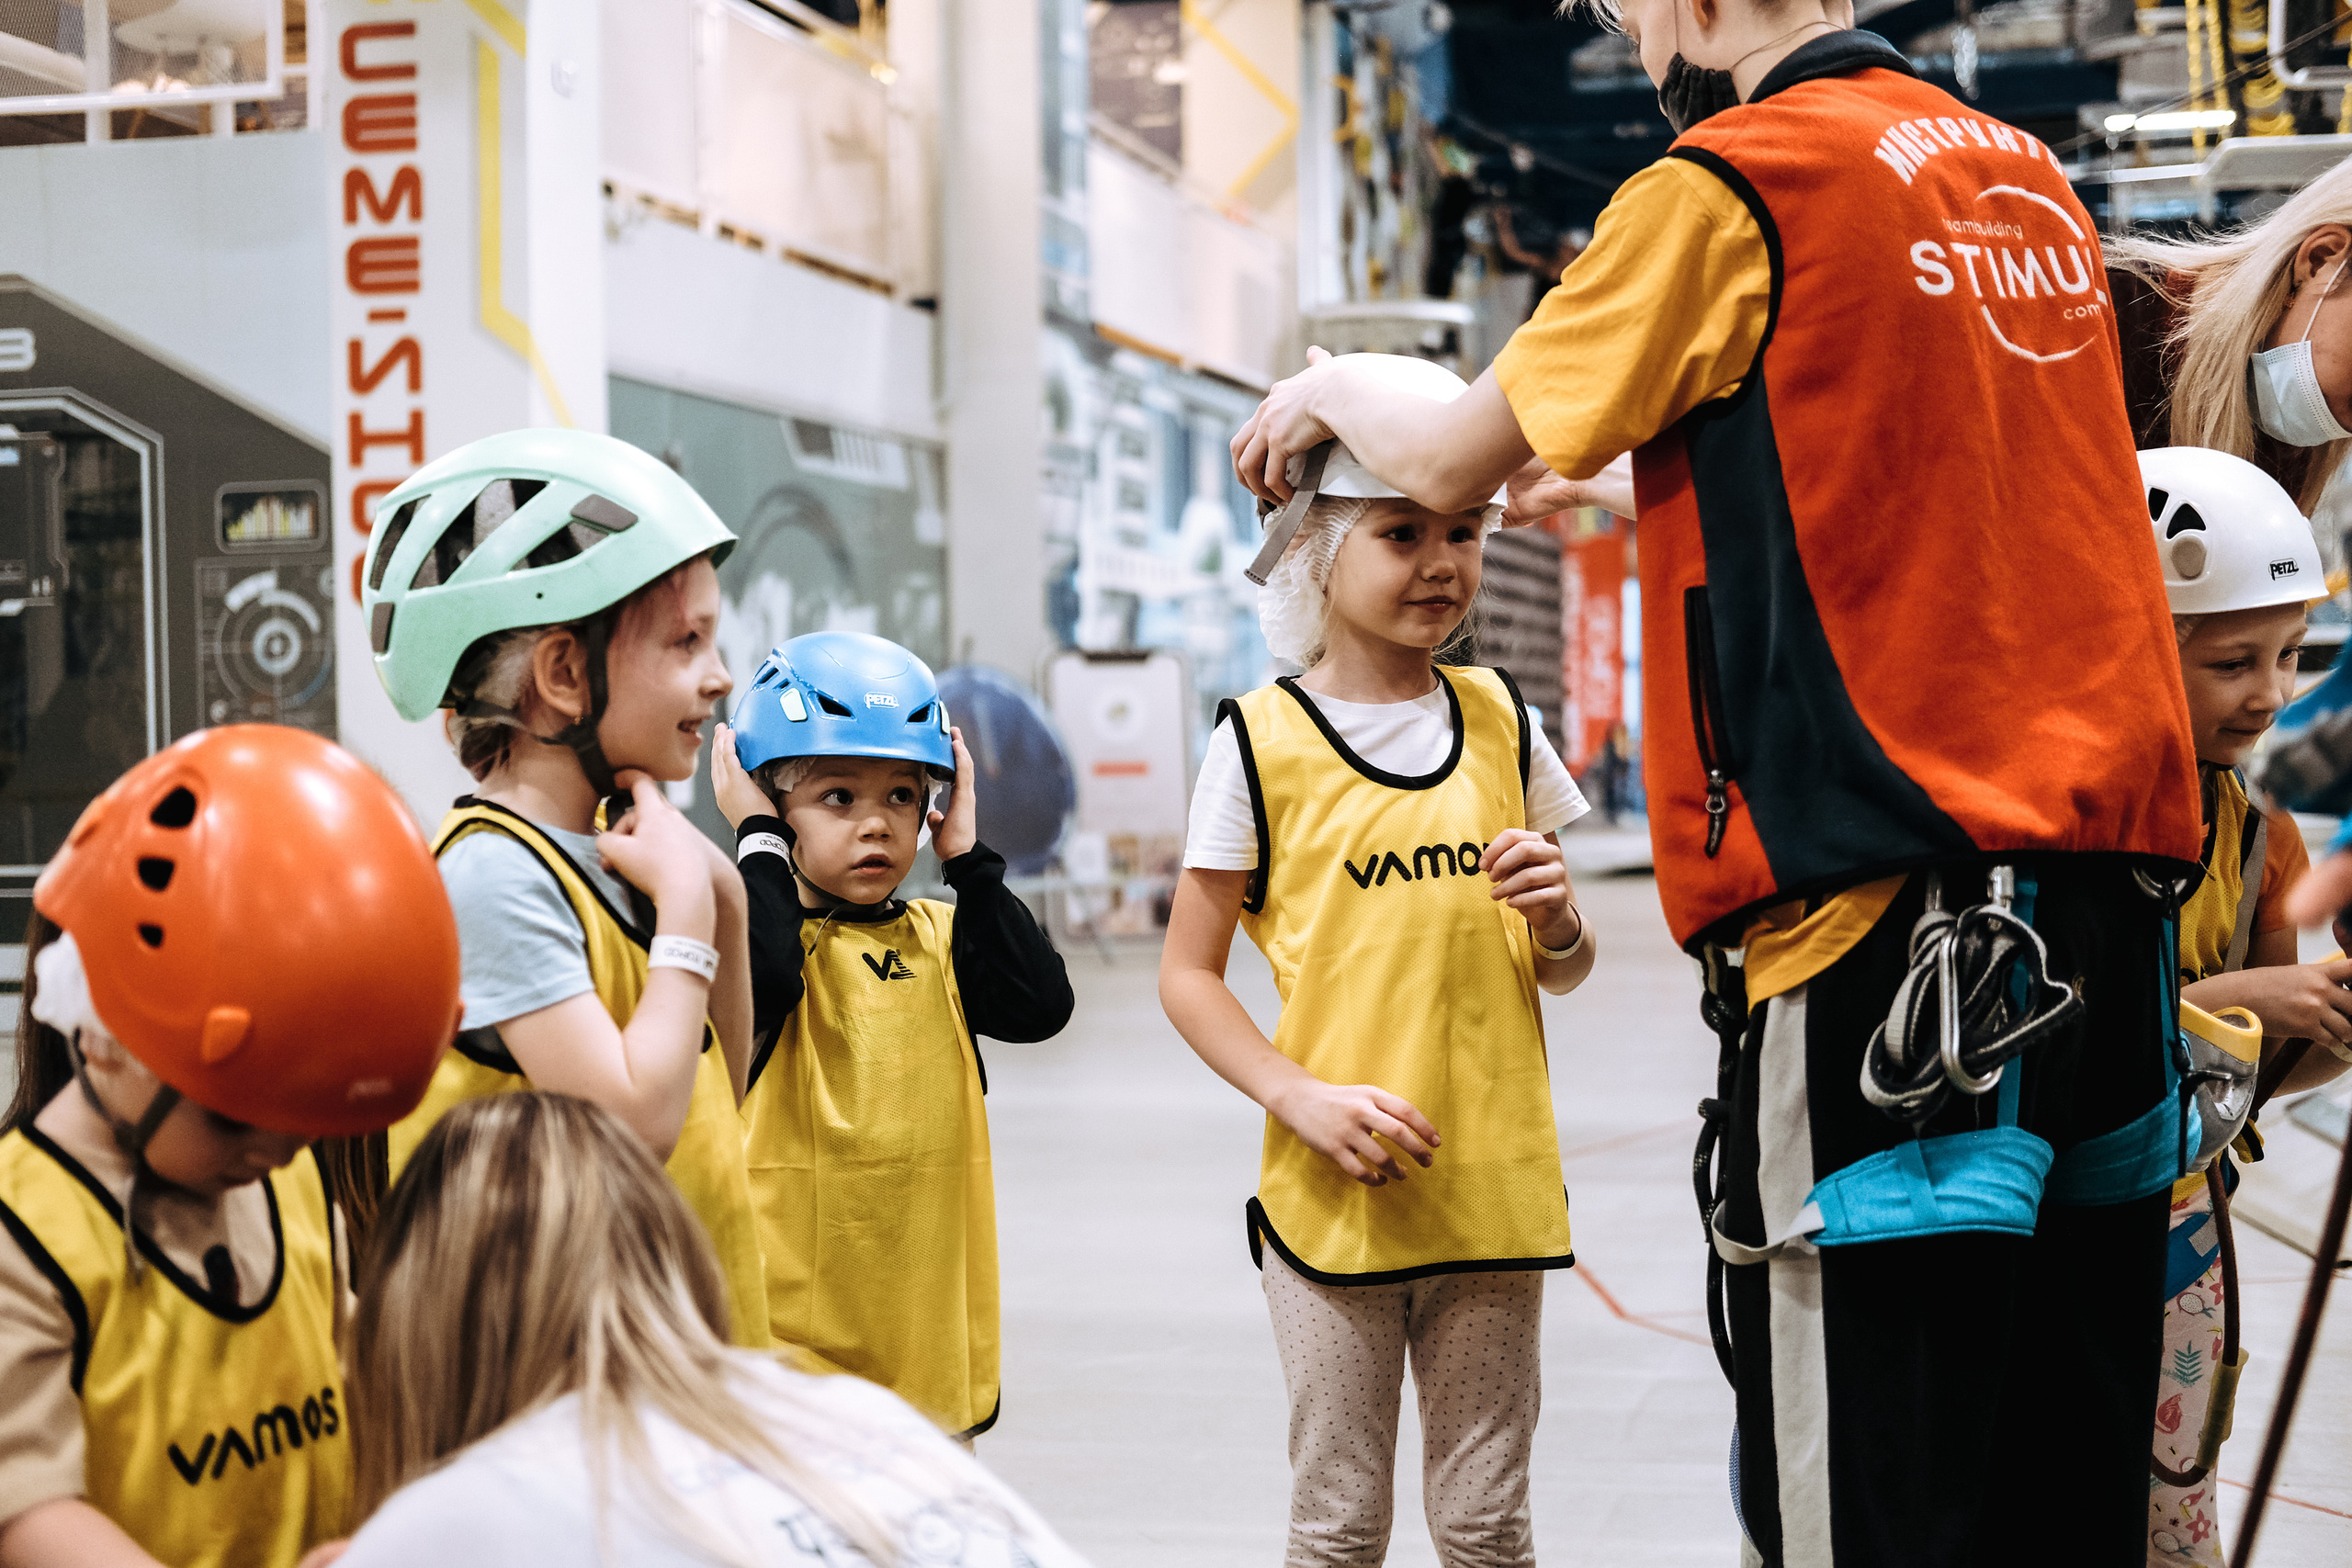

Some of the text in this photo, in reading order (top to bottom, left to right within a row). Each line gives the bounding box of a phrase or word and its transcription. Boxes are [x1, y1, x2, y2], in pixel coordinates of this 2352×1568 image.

[2269, 560, 2299, 581] PETZL
[865, 694, 899, 708] PETZL
[1344, 841, 1490, 889] VAMO
[167, 1387, 339, 1486] VAMOS
